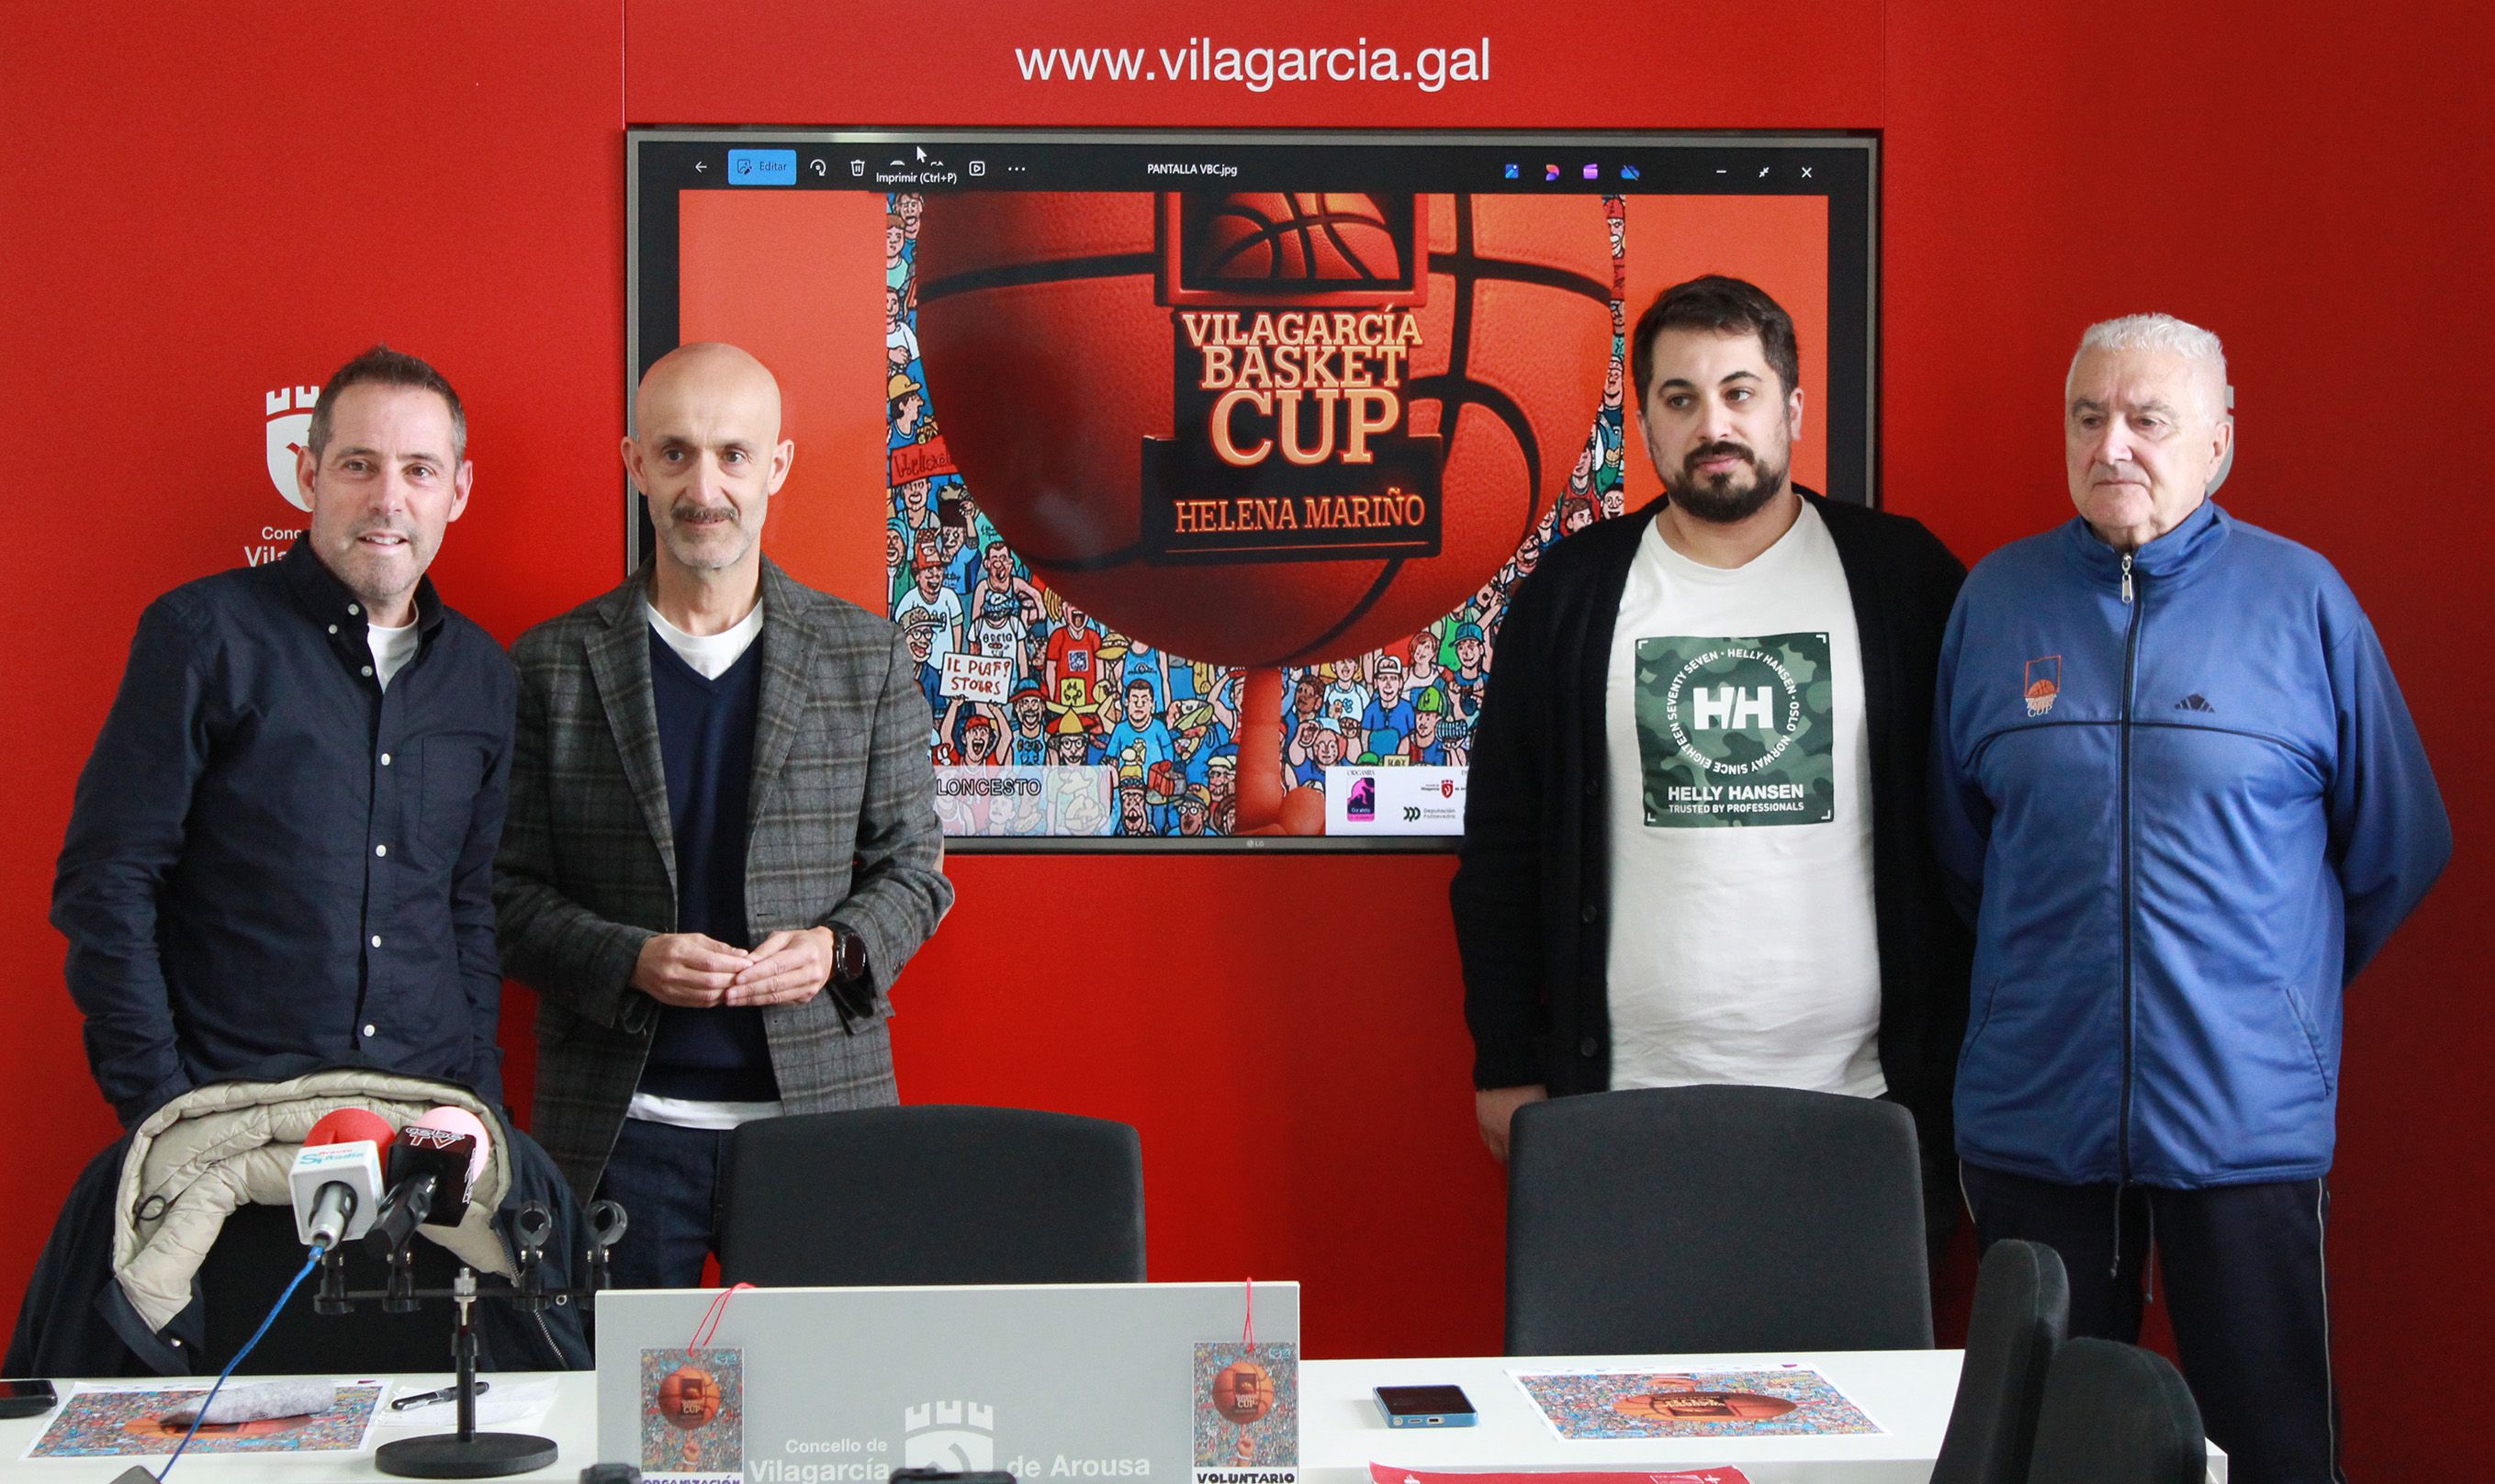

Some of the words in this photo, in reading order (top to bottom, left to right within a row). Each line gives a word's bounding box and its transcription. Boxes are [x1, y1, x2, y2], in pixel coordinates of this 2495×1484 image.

[1015, 37, 1490, 92] www.vilagarcia.gal
[759, 162, 787, 172] Editar
[876, 172, 917, 185] Imprimir
[919, 172, 957, 185] (Ctrl+P)
[1147, 163, 1197, 174] PANTALLA
[1199, 163, 1238, 177] VBC.jpg
[1182, 305, 1423, 346] VILAGARCÍA
[1201, 345, 1407, 389] BASKET
[1209, 388, 1401, 466] CUP
[1174, 499, 1298, 533] HELENA
[1304, 487, 1426, 529] MARIÑO
[1685, 650, 1718, 674] SEVEN
[1727, 648, 1763, 660] HELLY
[1762, 655, 1797, 695] HANSEN
[1667, 670, 1688, 720] SEVENTY
[1692, 685, 1773, 730] HH
[1786, 702, 1800, 732] OSLO
[1669, 722, 1713, 769] EIGHTEEN
[1751, 735, 1791, 772] NORWAY
[1713, 761, 1748, 775] SINCE
[1668, 786, 1724, 801] HELLY
[1728, 783, 1804, 801] HANSEN
[1669, 804, 1711, 814] TRUSTED
[1712, 804, 1725, 814] BY
[1726, 802, 1804, 814] PROFESSIONALS
[785, 1437, 861, 1454] Concello
[865, 1438, 888, 1453] de
[748, 1457, 890, 1484] Vilagarcía
[1006, 1456, 1040, 1478] de
[1049, 1454, 1151, 1478] Arousa
[1197, 1473, 1295, 1484] VOLUNTARIO
